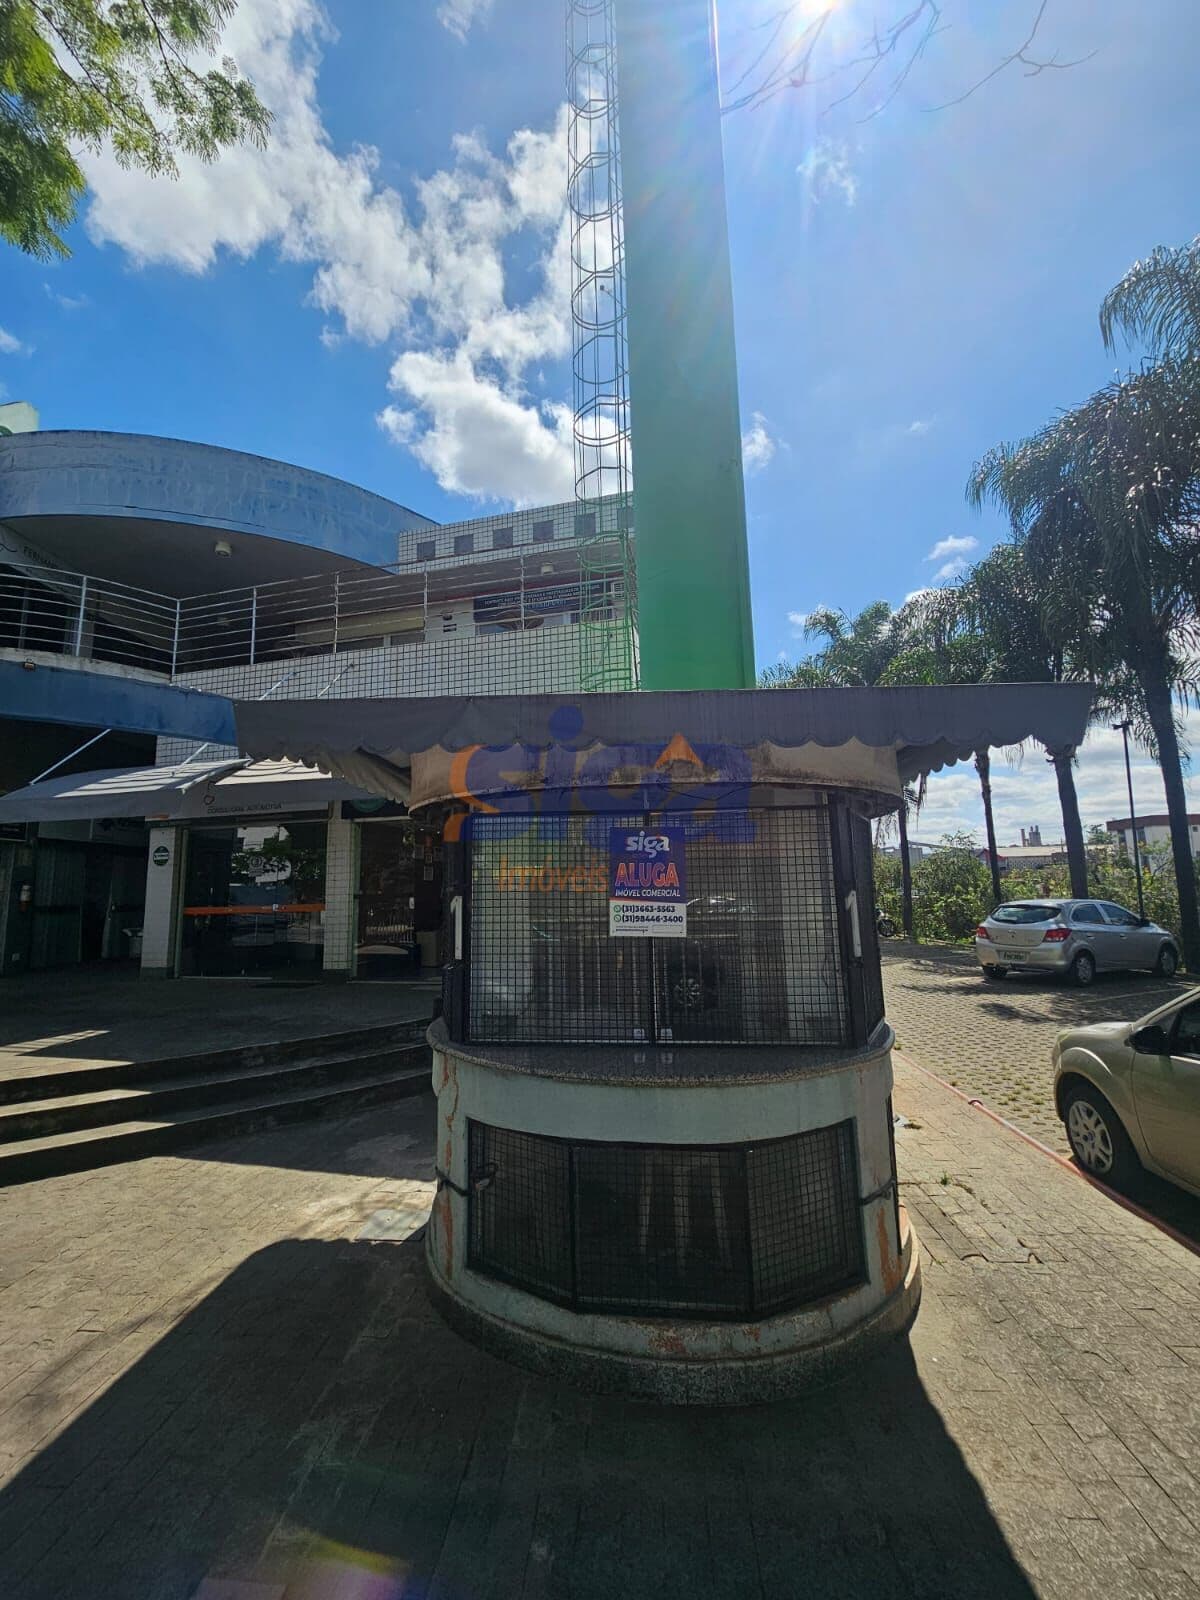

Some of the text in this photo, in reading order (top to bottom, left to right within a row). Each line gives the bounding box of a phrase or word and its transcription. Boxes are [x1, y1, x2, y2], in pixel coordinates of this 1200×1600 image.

[625, 830, 670, 858] siga
[615, 862, 680, 887] ALUGA
[615, 887, 681, 897] IMÓVEL COMERCIAL
